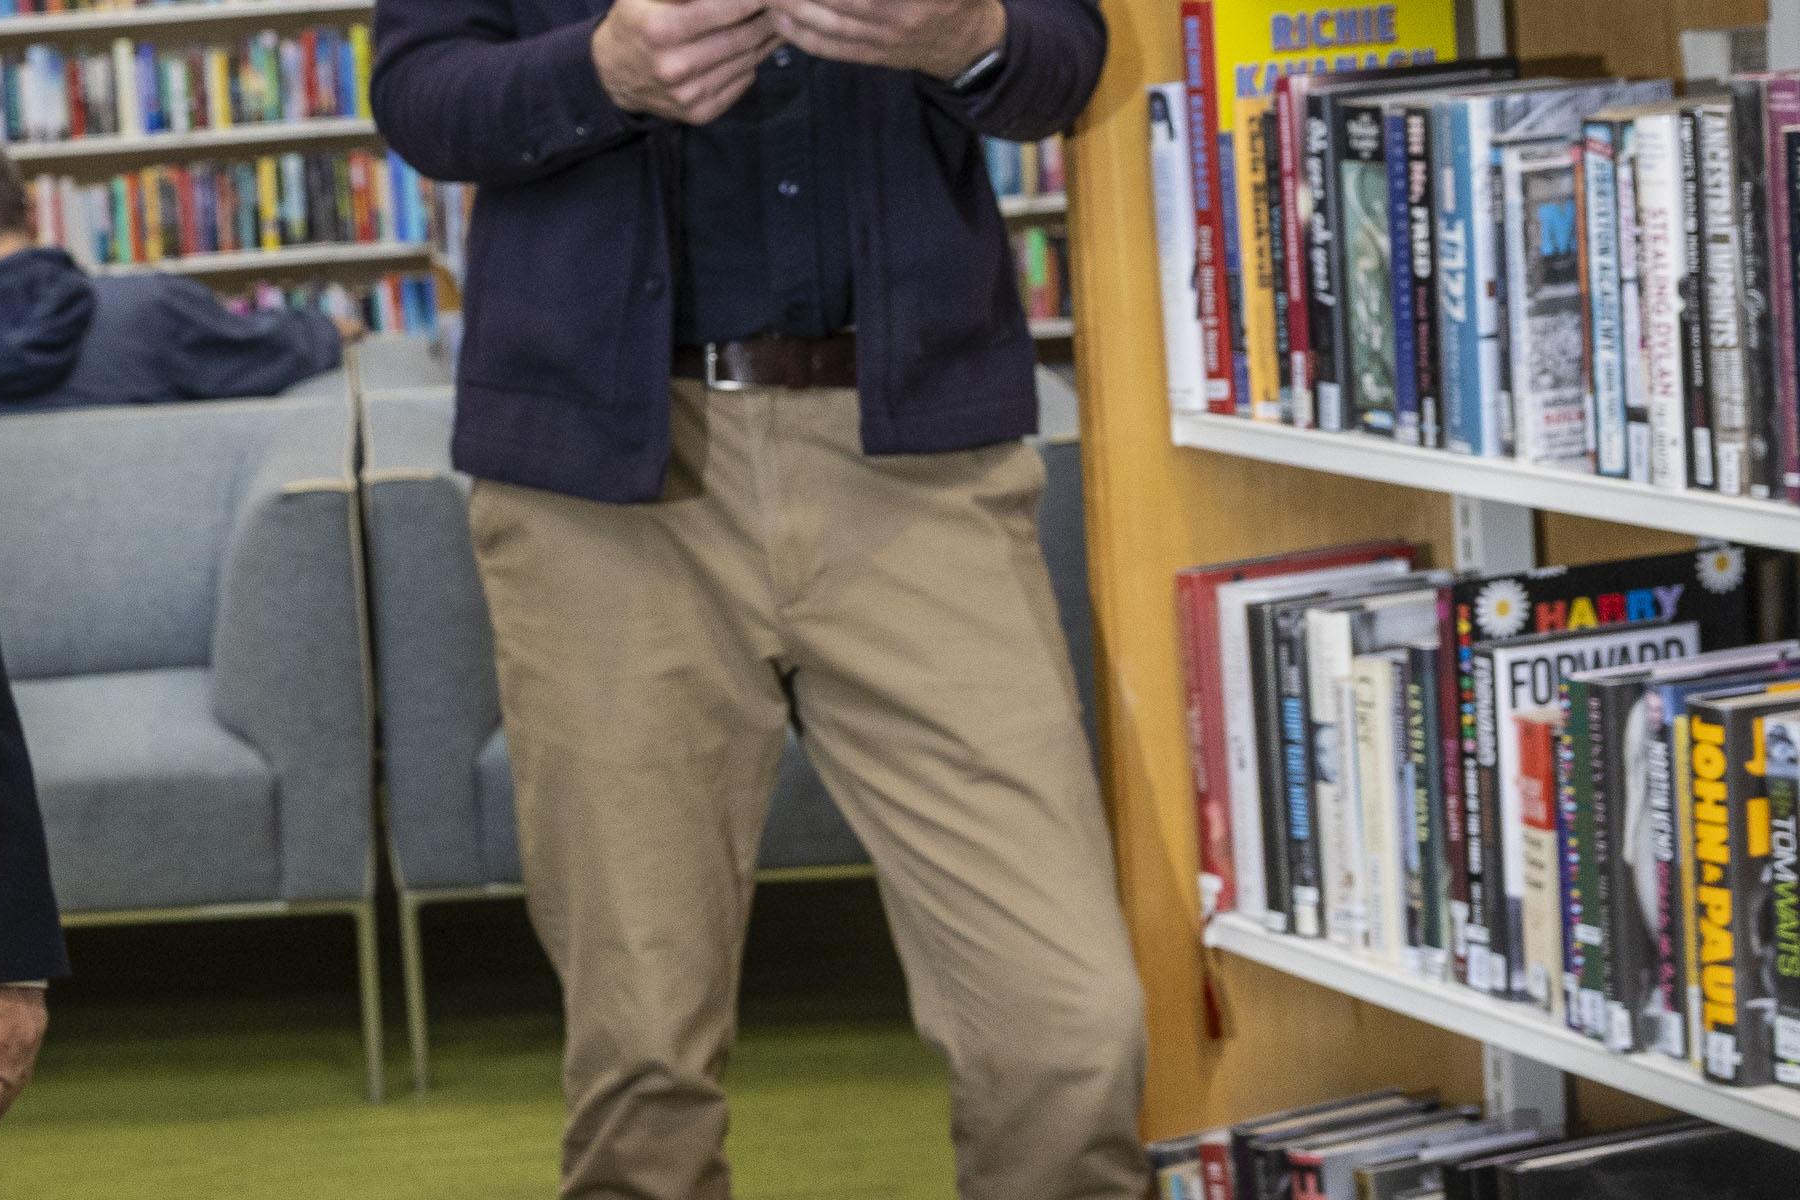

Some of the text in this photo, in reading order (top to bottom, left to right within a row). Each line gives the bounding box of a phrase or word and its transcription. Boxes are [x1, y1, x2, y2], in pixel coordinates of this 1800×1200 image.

[1271, 3, 1397, 54] RICHIE
[1648, 207, 1673, 315] STEALING
[1653, 322, 1676, 399] DYLAN
[1535, 583, 1685, 633] HARRY
[1690, 715, 1731, 864] JOHN
[1771, 815, 1800, 977] TOM WAITS
[1698, 885, 1737, 1032] PAUL
